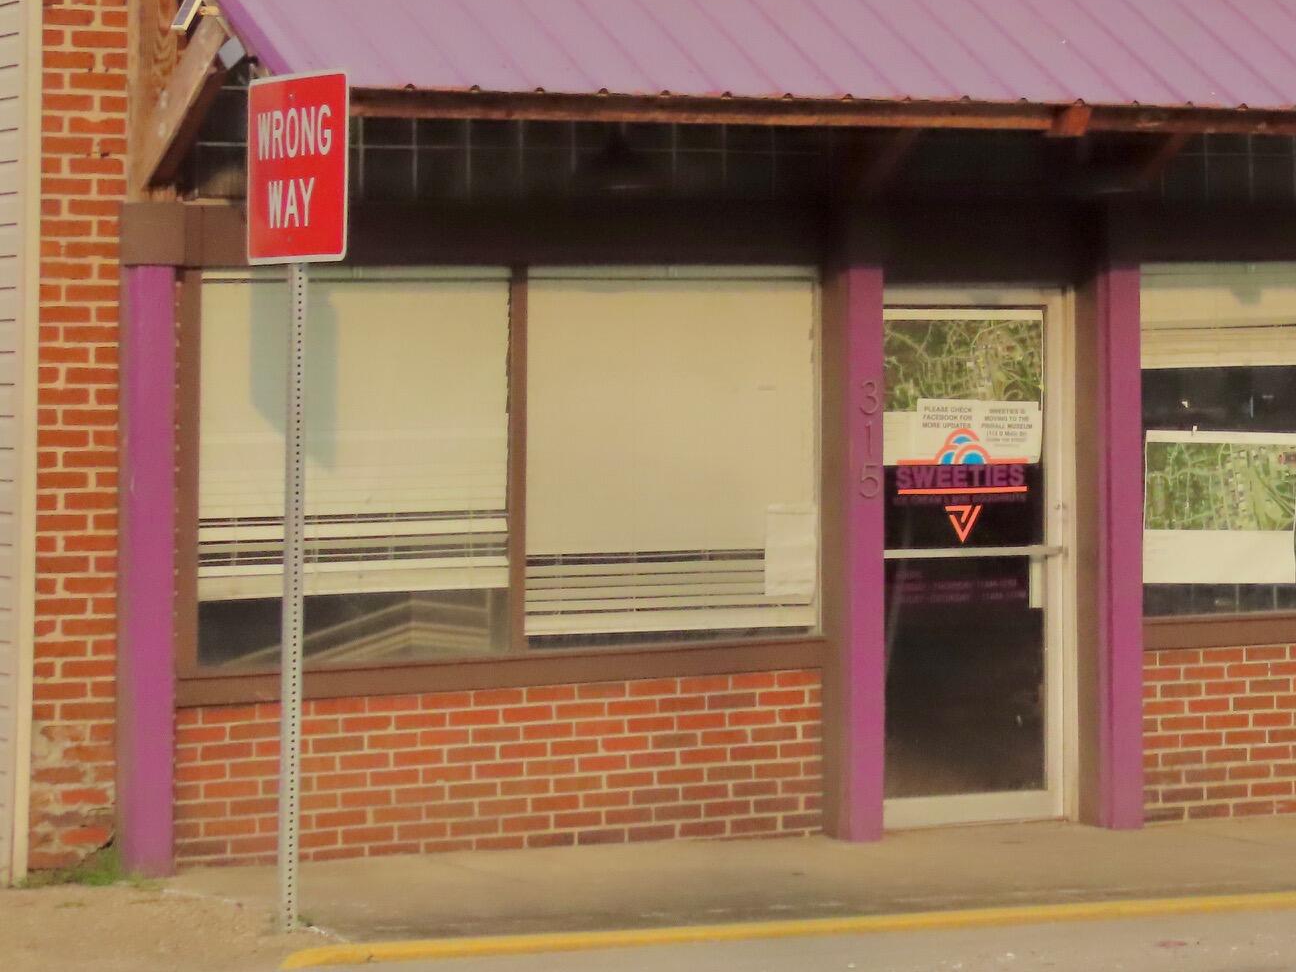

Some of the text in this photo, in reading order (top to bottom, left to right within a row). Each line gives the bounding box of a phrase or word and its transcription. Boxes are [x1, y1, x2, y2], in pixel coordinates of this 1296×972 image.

[257, 104, 332, 160] WRONG
[268, 177, 315, 228] WAY
[859, 380, 880, 499] 315
[922, 421, 972, 429] MORE UPDATES
[896, 464, 1025, 489] SWEETIES
